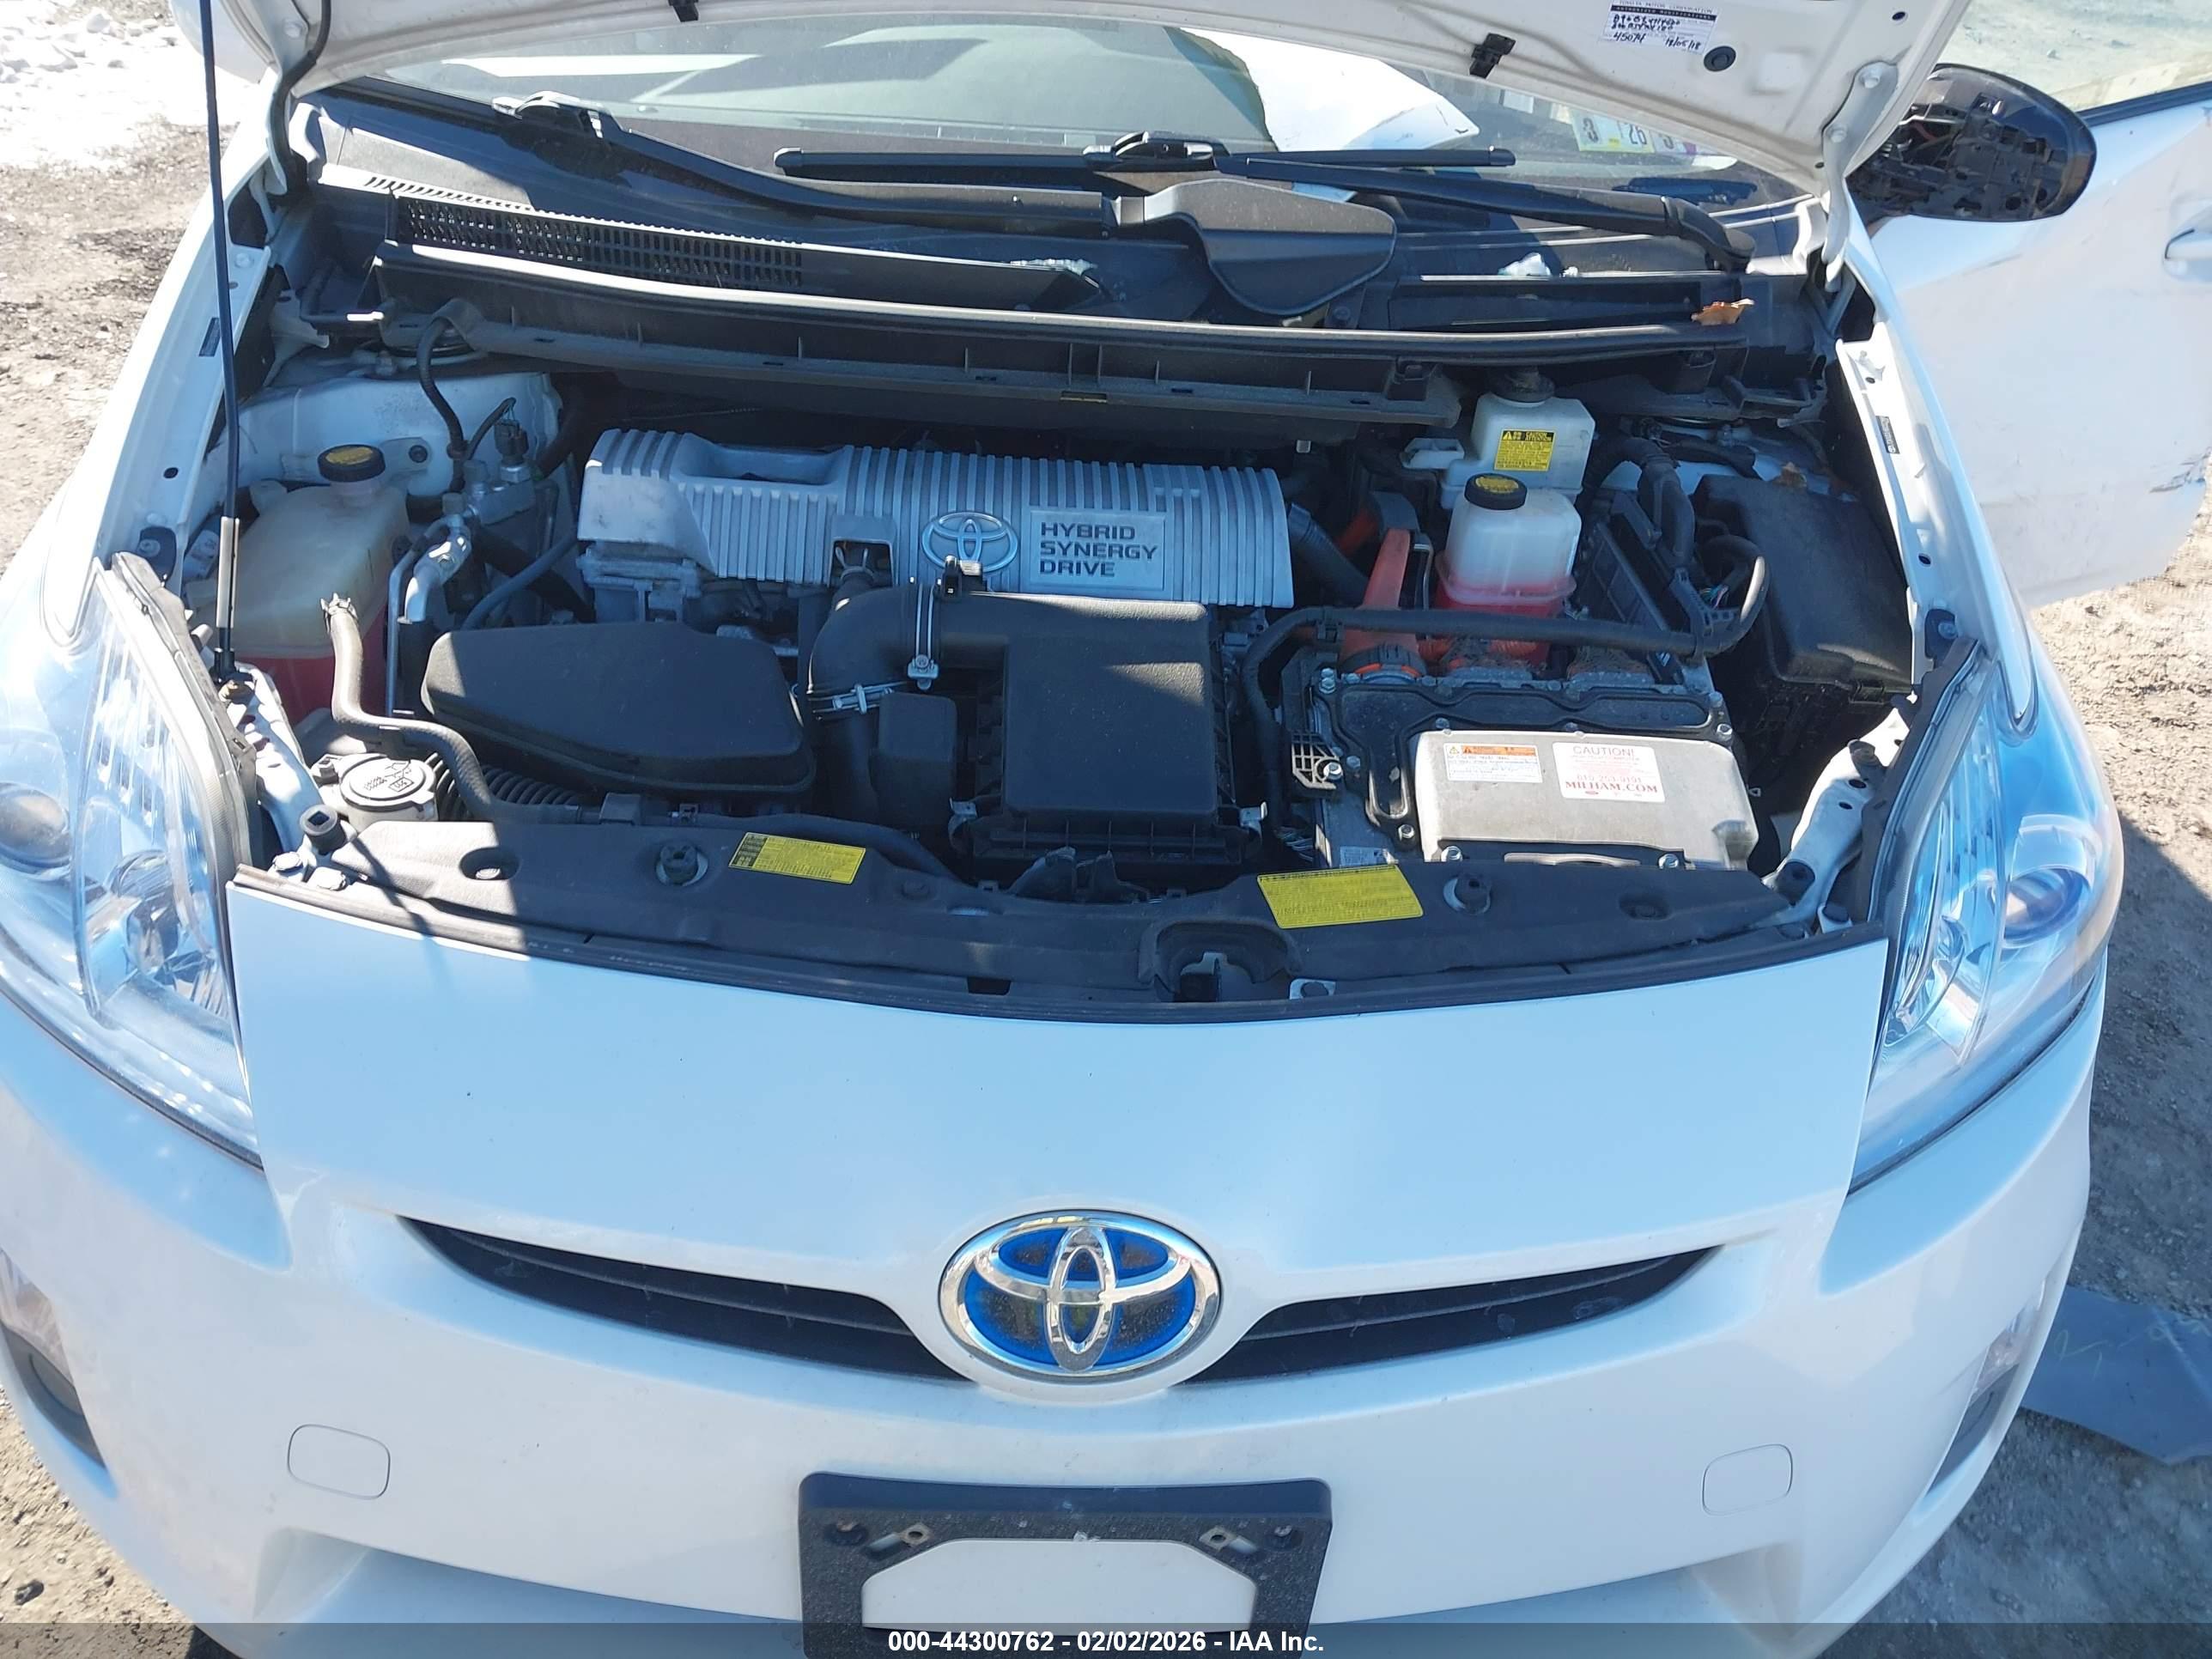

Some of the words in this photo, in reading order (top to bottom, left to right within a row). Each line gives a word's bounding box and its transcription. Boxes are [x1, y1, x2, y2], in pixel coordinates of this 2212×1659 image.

[1582, 117, 1599, 143] 3
[1041, 521, 1136, 540] HYBRID
[1040, 540, 1158, 560] SYNERGY
[1039, 558, 1115, 577] DRIVE
[1572, 745, 1635, 757] CAUTION!
